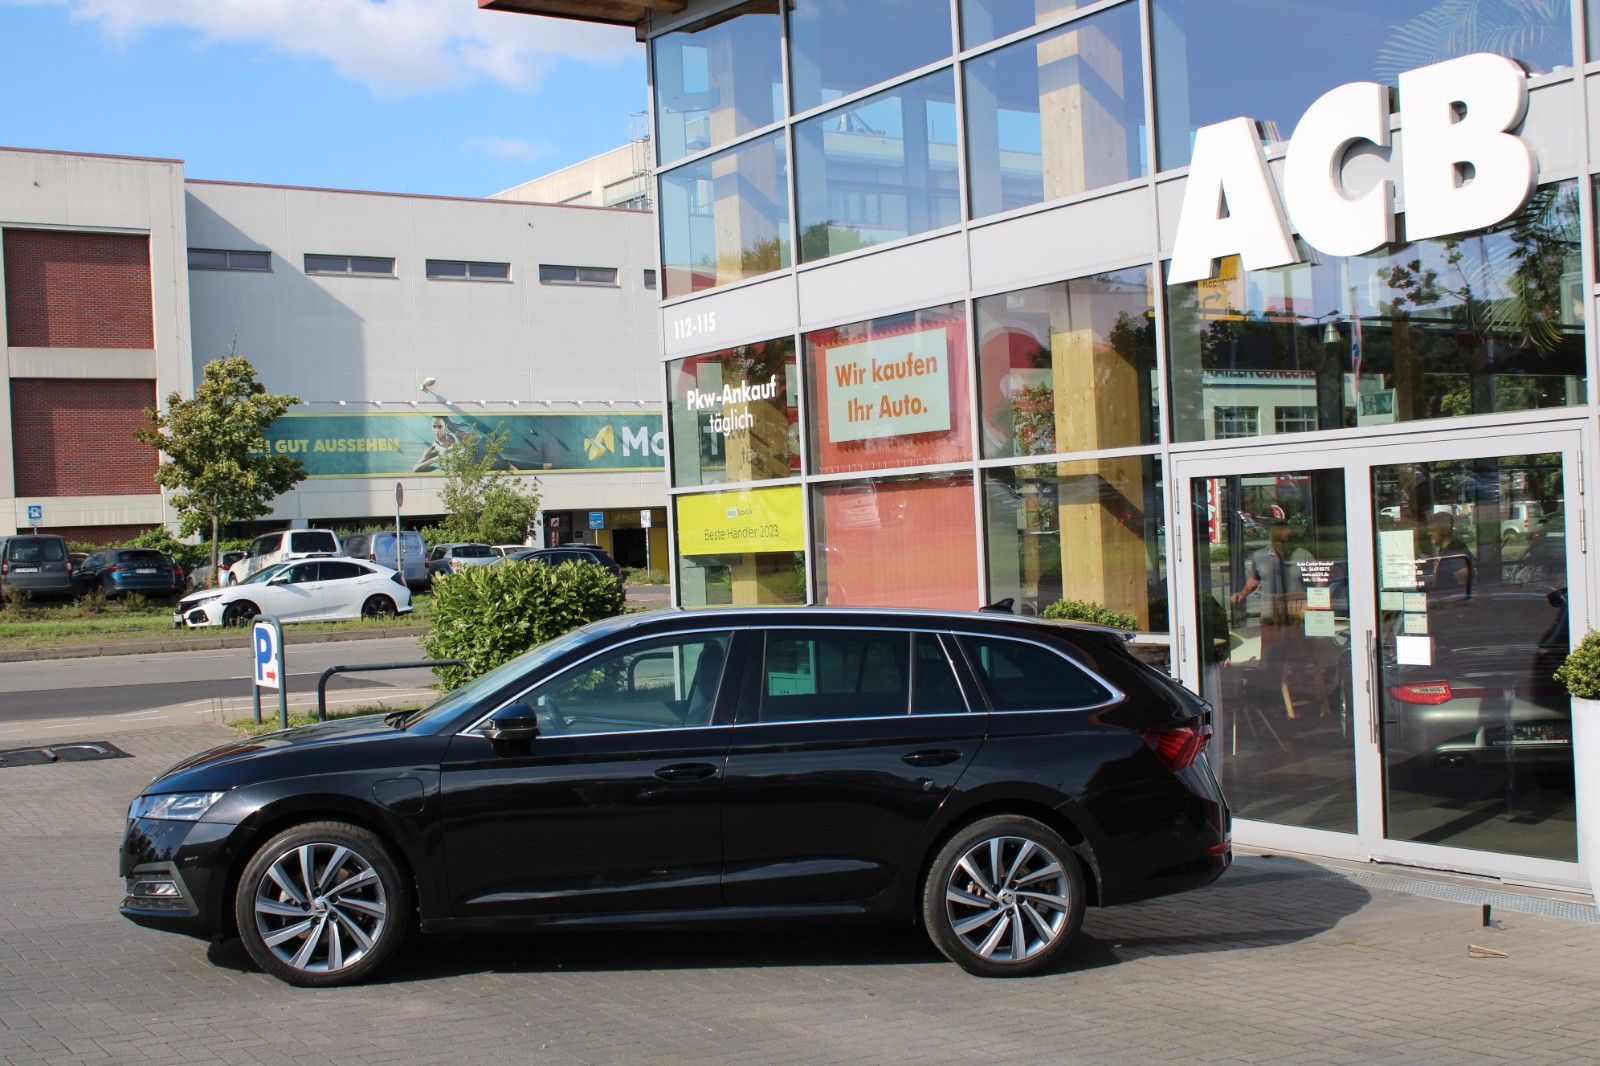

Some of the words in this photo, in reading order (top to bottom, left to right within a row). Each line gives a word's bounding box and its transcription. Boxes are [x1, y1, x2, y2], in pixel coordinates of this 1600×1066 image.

[1167, 53, 1539, 285] ACB
[674, 311, 716, 340] 112-115
[835, 360, 865, 387] Wir
[872, 351, 938, 382] kaufen
[686, 374, 777, 411] Pkw-Ankauf
[709, 406, 754, 437] täglich
[847, 398, 873, 423] Ihr
[879, 394, 928, 418] Auto.
[275, 439, 309, 454] GUT
[313, 437, 400, 453] AUSSEHEN
[704, 528, 725, 541] Beste
[728, 526, 758, 540] Händler
[760, 524, 779, 538] 2023
[255, 626, 272, 681] P
